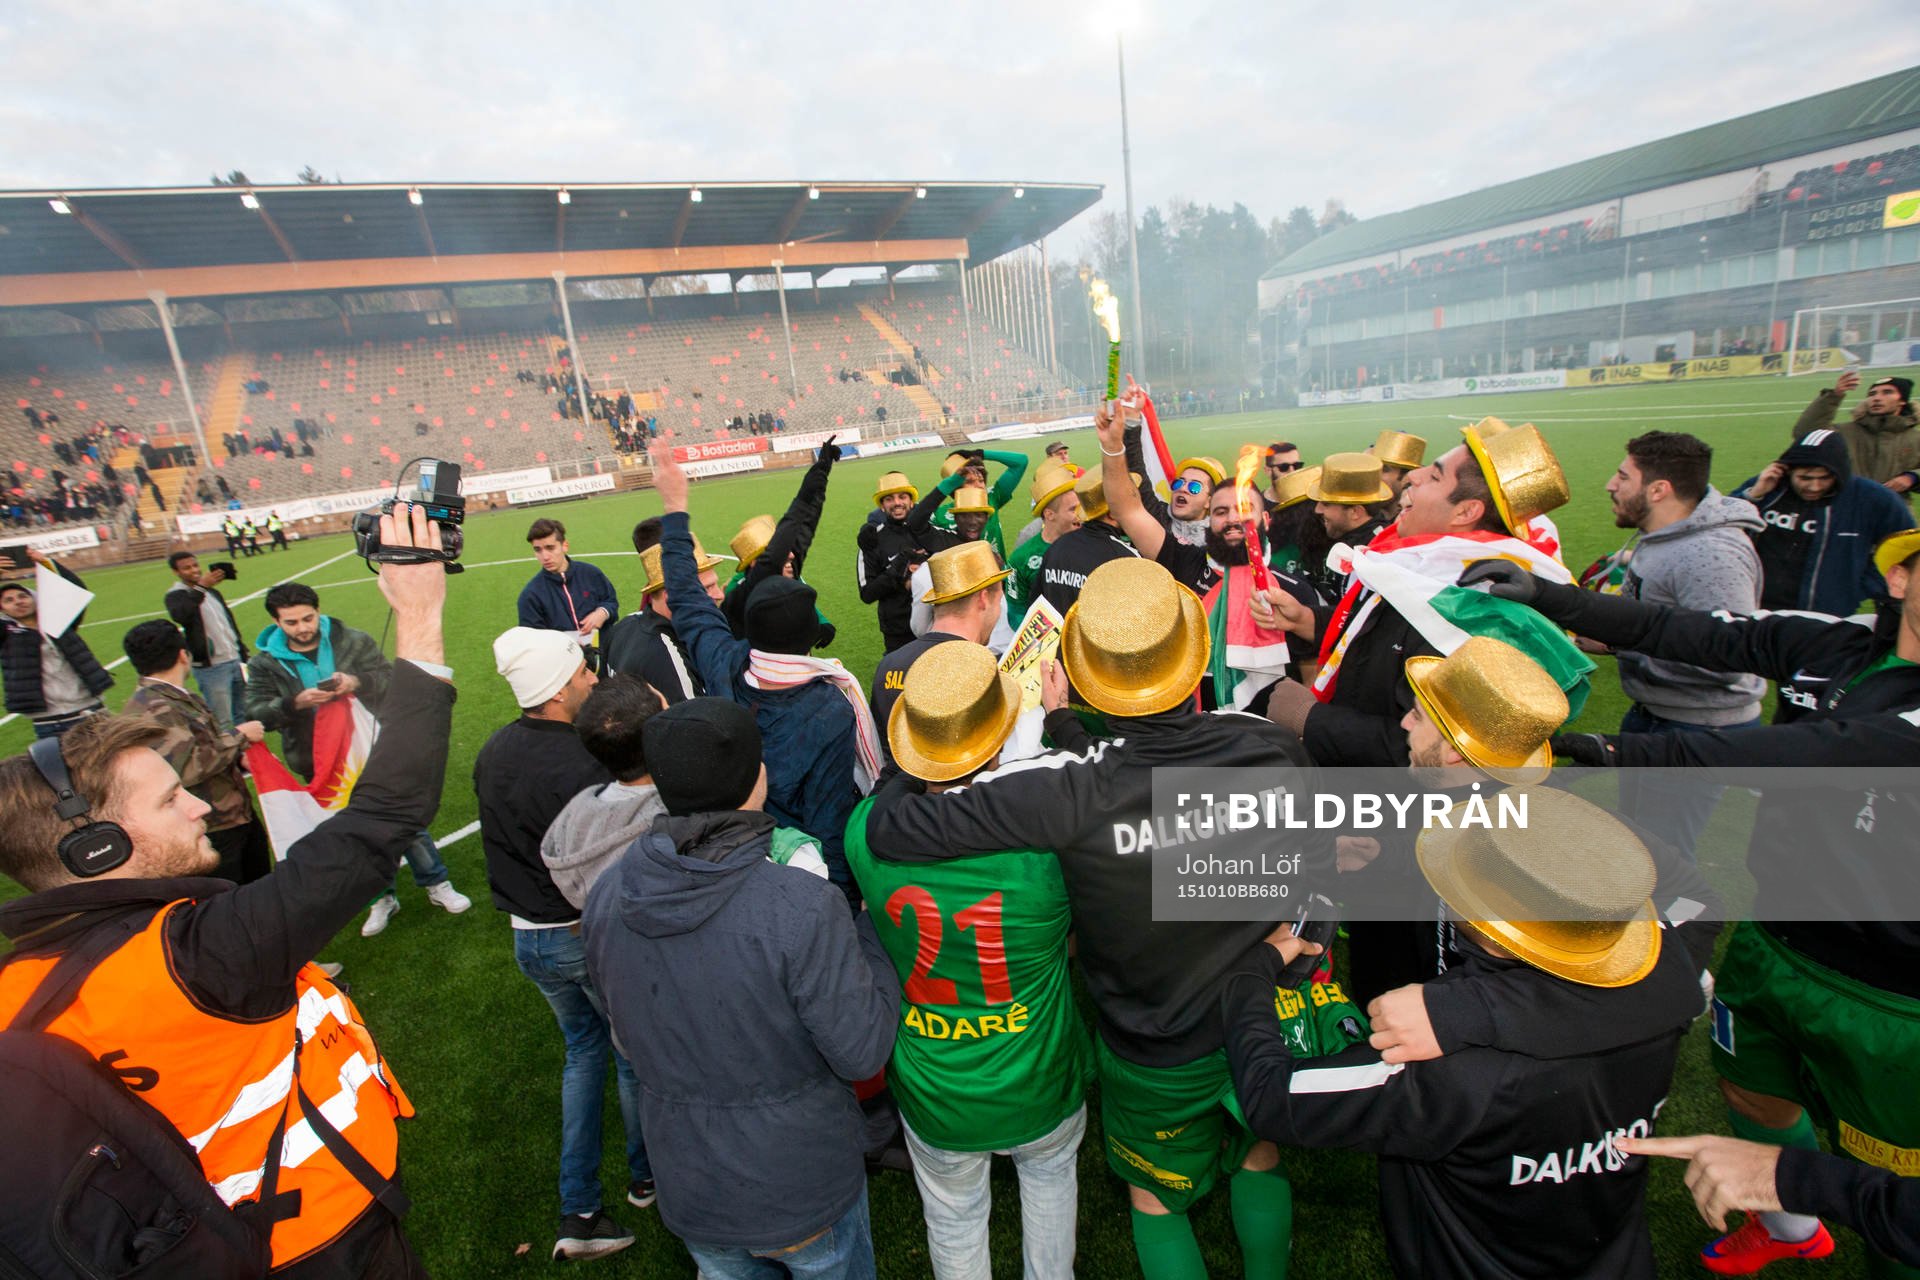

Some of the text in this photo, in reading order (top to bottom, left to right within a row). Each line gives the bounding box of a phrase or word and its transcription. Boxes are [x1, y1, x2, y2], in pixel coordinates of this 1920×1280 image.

[1610, 366, 1642, 378] INAB
[1693, 359, 1730, 373] INAB
[702, 441, 756, 457] Bostaden
[882, 437, 922, 448] PEAB
[885, 885, 1014, 1006] 21
[905, 1002, 1029, 1040] ADARÊ
